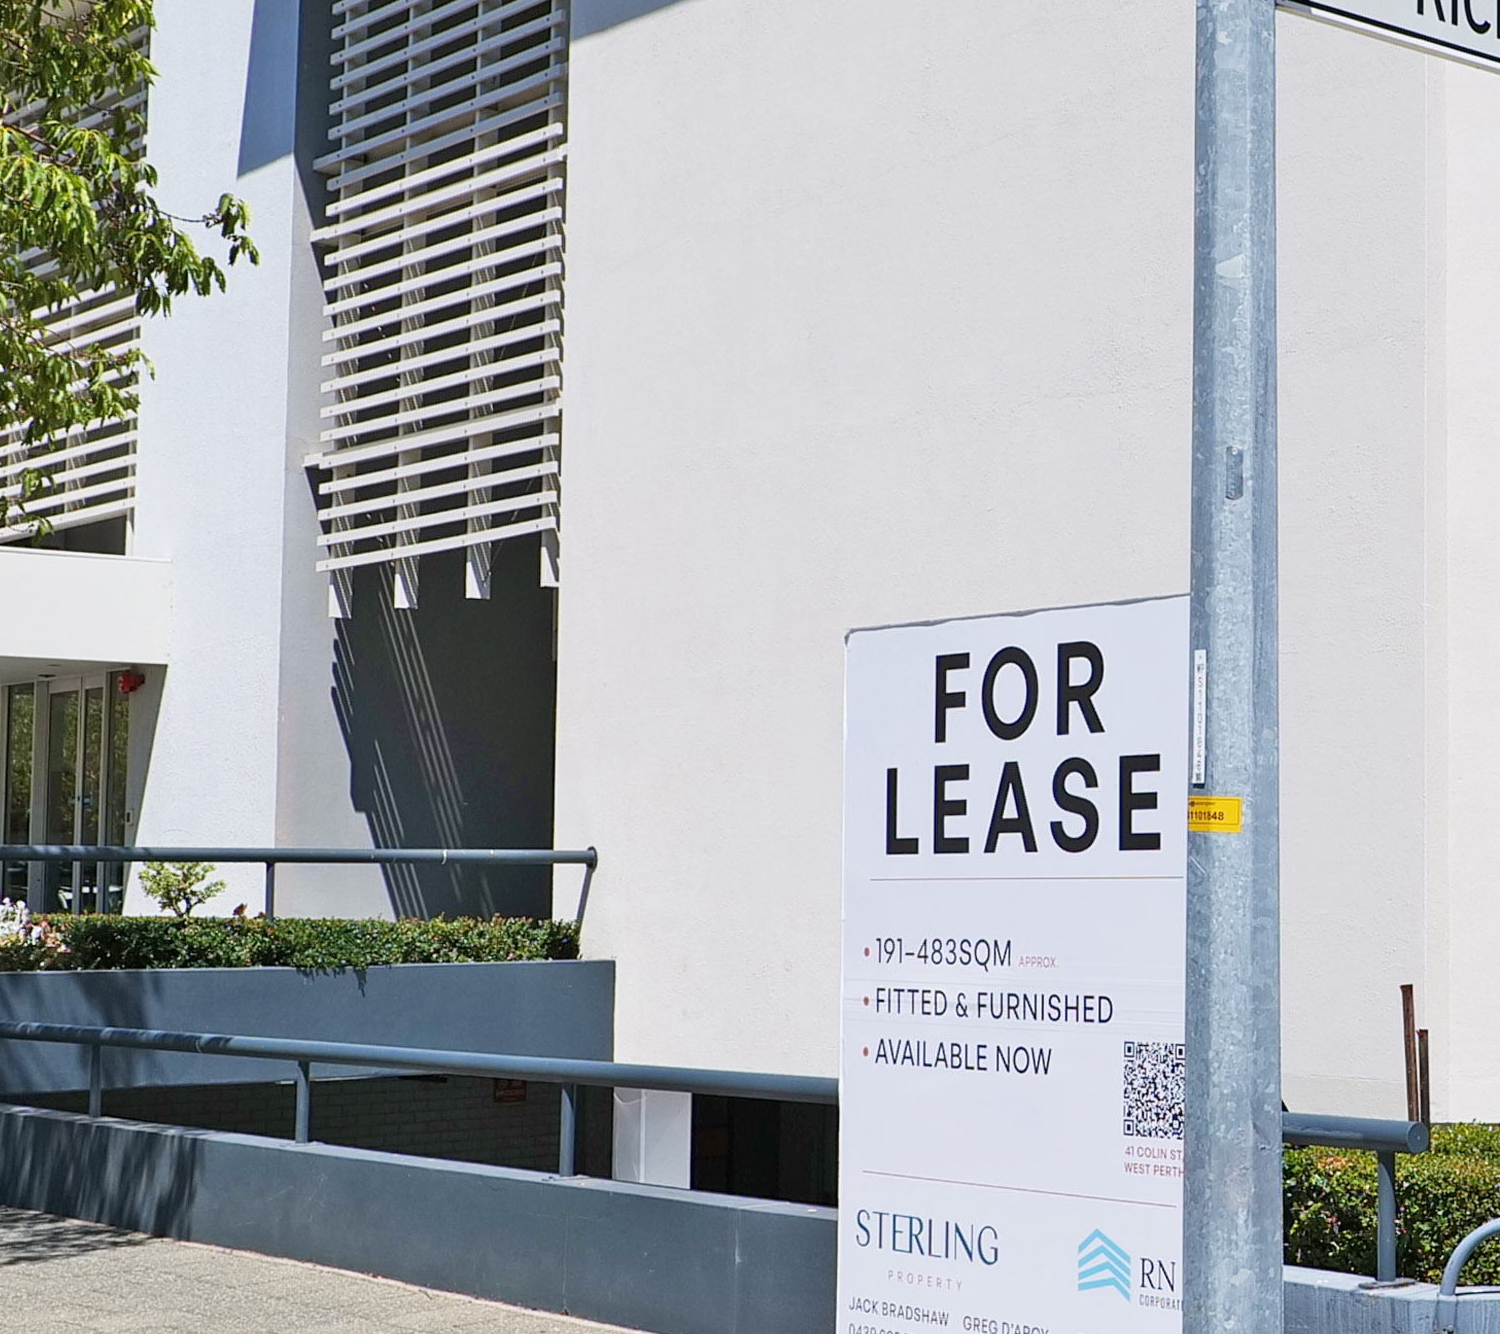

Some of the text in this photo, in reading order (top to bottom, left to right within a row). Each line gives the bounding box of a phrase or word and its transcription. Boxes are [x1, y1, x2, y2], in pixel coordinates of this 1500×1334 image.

[934, 641, 1105, 743] FOR
[886, 753, 1161, 855] LEASE
[876, 938, 1059, 972] 191-483SQM APPROX.
[876, 988, 1113, 1024] FITTED & FURNISHED
[875, 1038, 1052, 1075] AVAILABLE NOW
[1124, 1161, 1150, 1175] WEST
[1125, 1145, 1135, 1157] 41
[1137, 1146, 1167, 1160] COLIN
[856, 1209, 999, 1266] STERLING
[888, 1269, 963, 1291] PROPERTY
[1140, 1257, 1176, 1293] RN
[849, 1296, 950, 1327] JACK BRADSHAW
[1139, 1294, 1184, 1312] CORPORAT
